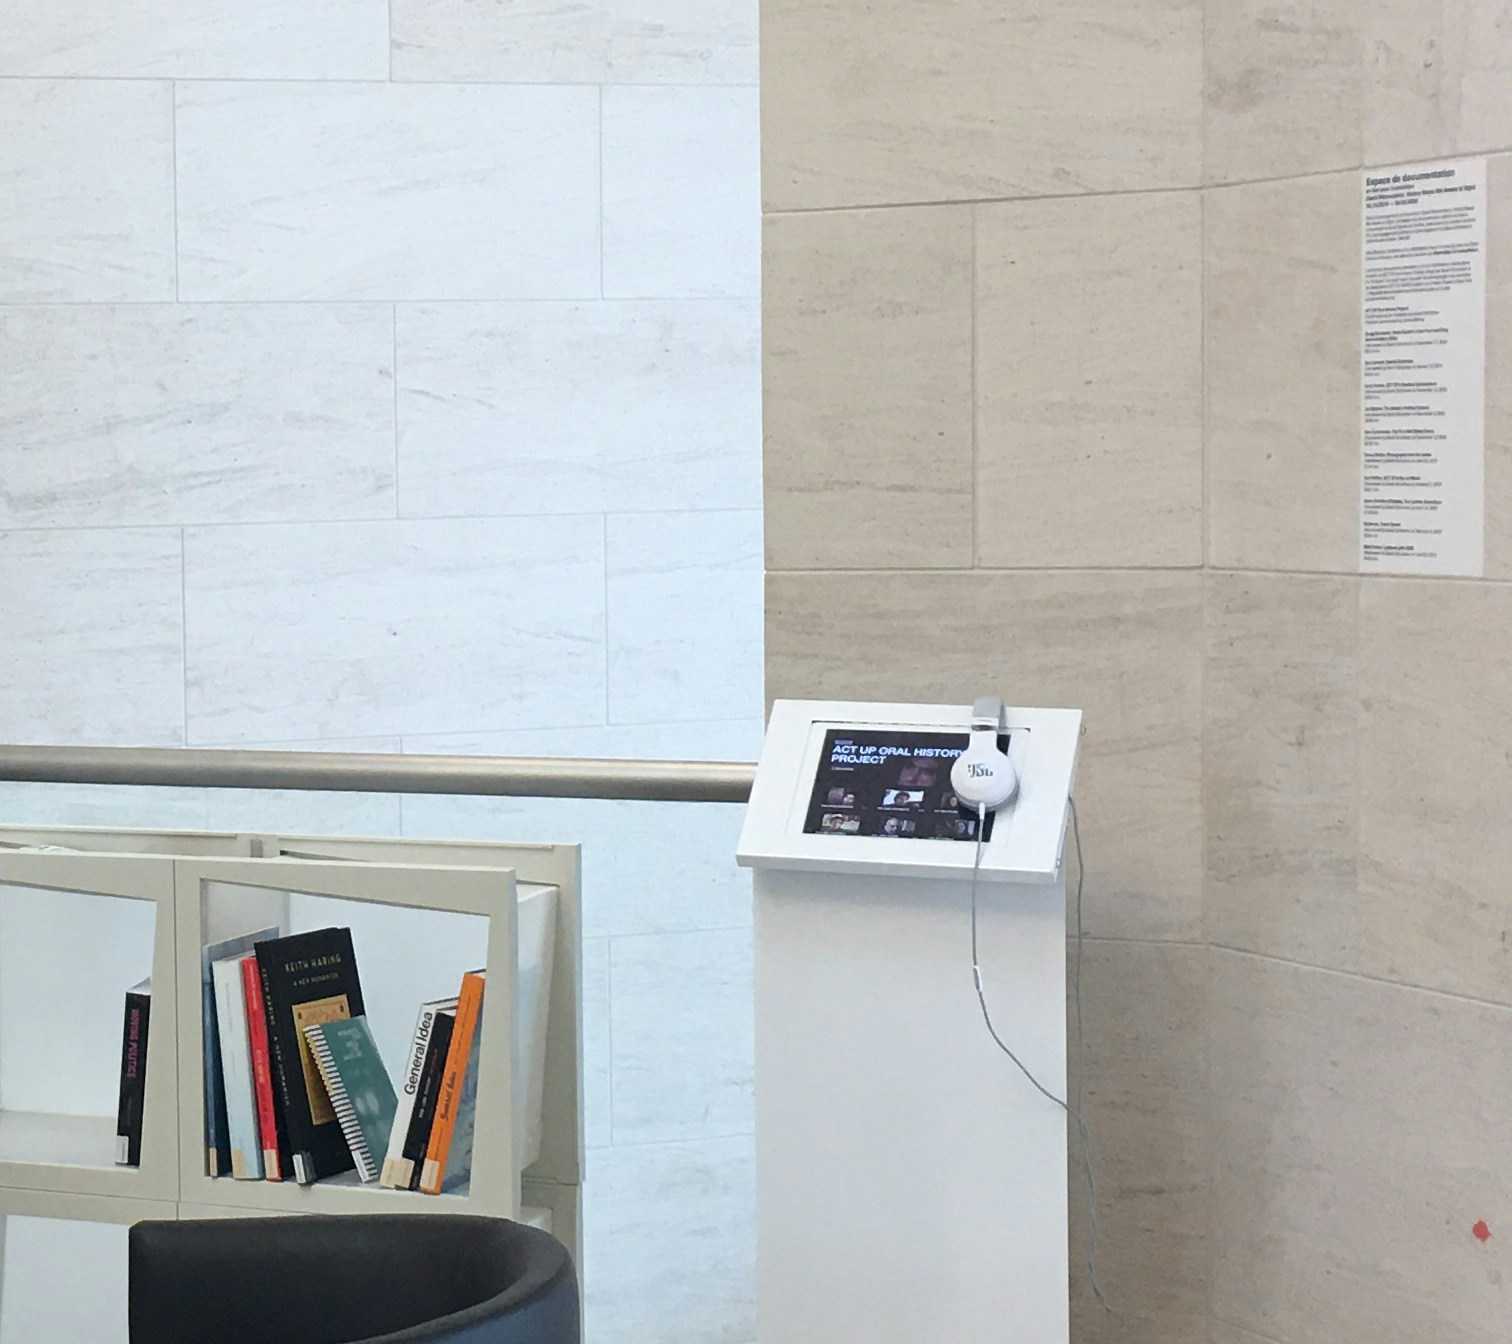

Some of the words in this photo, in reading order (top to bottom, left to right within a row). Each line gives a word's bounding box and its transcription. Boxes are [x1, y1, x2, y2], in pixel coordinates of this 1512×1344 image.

[832, 745, 858, 754] ACT
[860, 746, 877, 755] UP
[878, 747, 911, 756] ORAL
[831, 754, 887, 764] PROJECT
[404, 1041, 426, 1094] General
[416, 1012, 433, 1042] Idea
